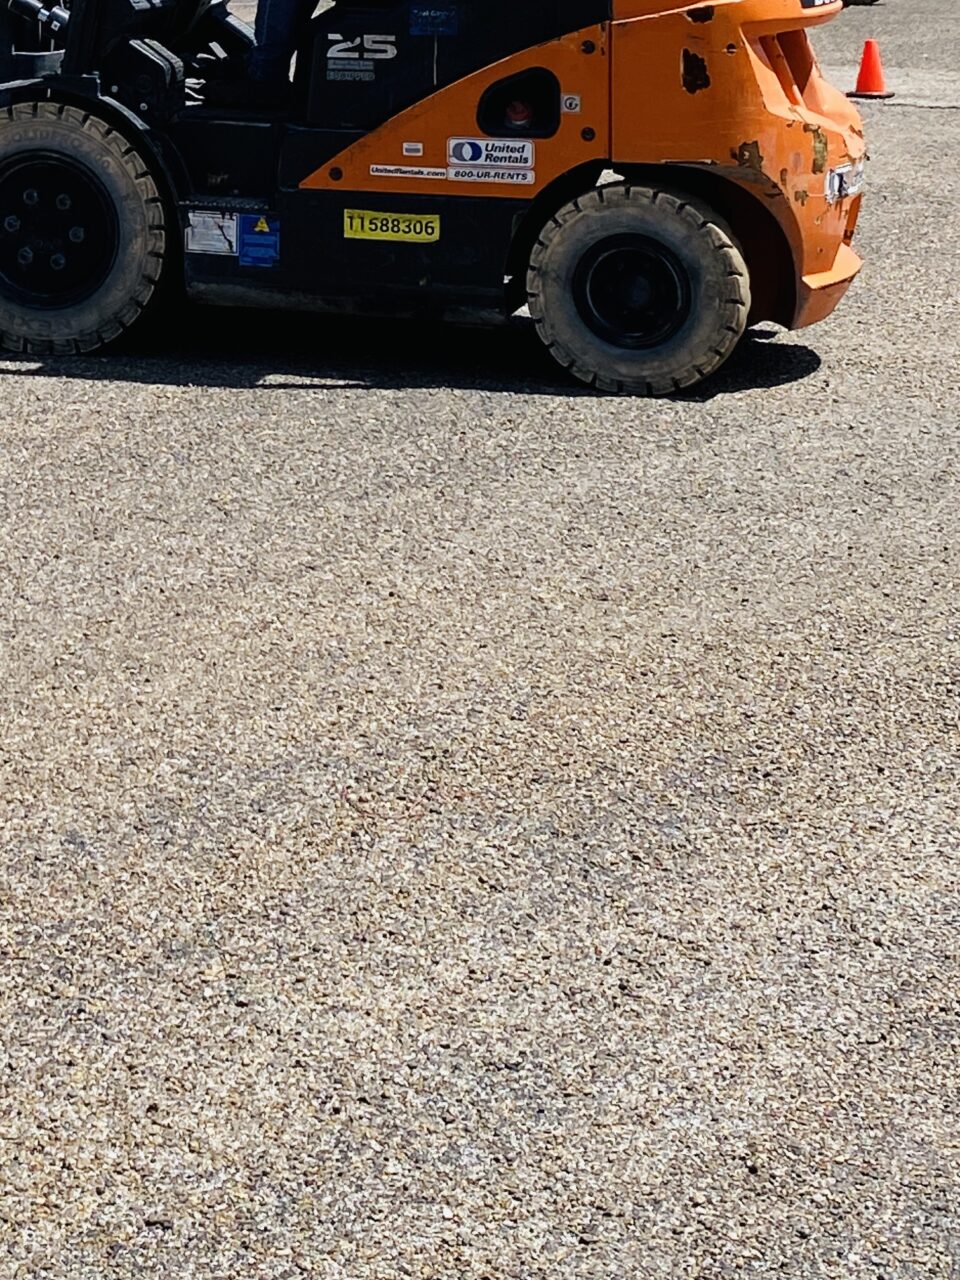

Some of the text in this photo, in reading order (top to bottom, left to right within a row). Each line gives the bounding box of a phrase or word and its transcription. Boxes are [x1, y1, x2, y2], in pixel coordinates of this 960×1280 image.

[326, 33, 398, 59] 25
[485, 143, 525, 154] United
[484, 154, 529, 164] Rentals
[371, 166, 446, 177] UnitedRentals.com
[454, 170, 528, 181] 800-UR-RENTS
[347, 213, 435, 236] 11588306
